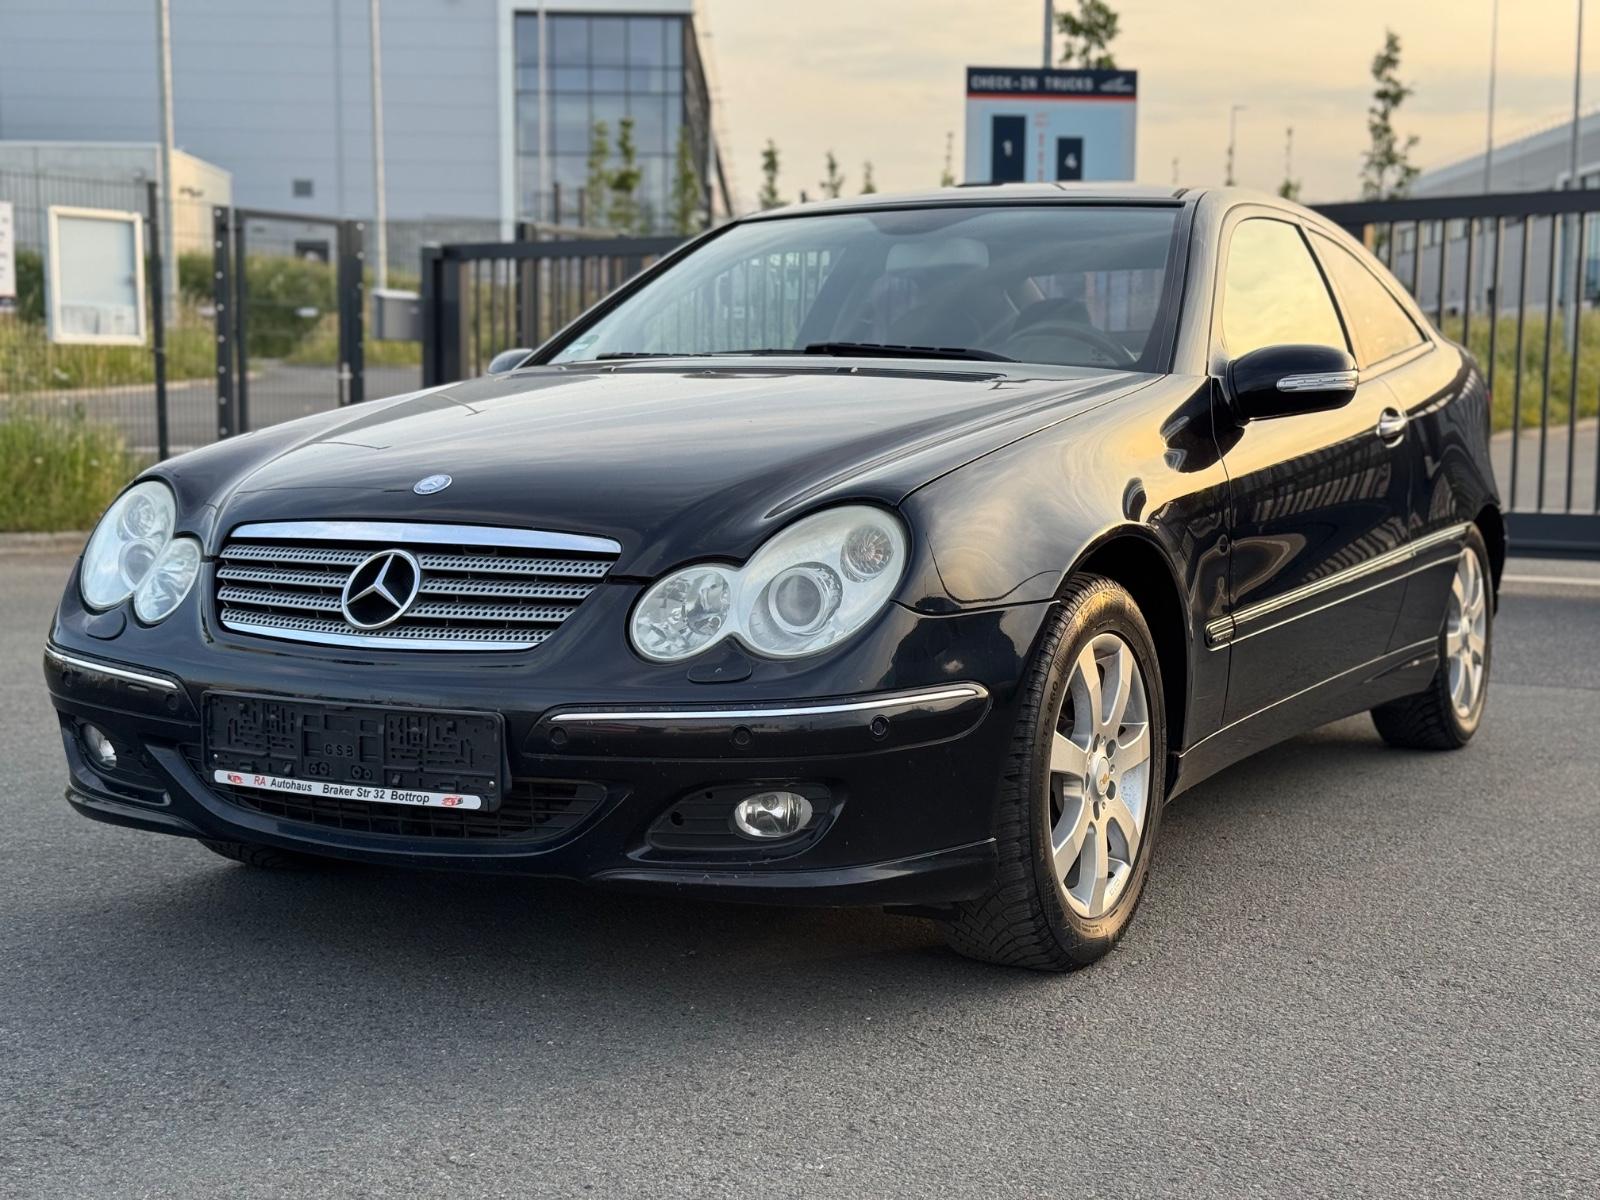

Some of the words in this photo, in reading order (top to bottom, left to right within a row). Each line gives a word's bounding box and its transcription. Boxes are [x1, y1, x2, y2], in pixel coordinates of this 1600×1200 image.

[970, 75, 1038, 90] CHECK-IN
[1044, 76, 1094, 91] TRUCKS
[253, 775, 267, 786] RA
[270, 778, 313, 792] Autohaus
[322, 784, 355, 796] Braker
[356, 787, 372, 798] Str
[373, 789, 386, 799] 32
[390, 790, 430, 805] Bottrop
